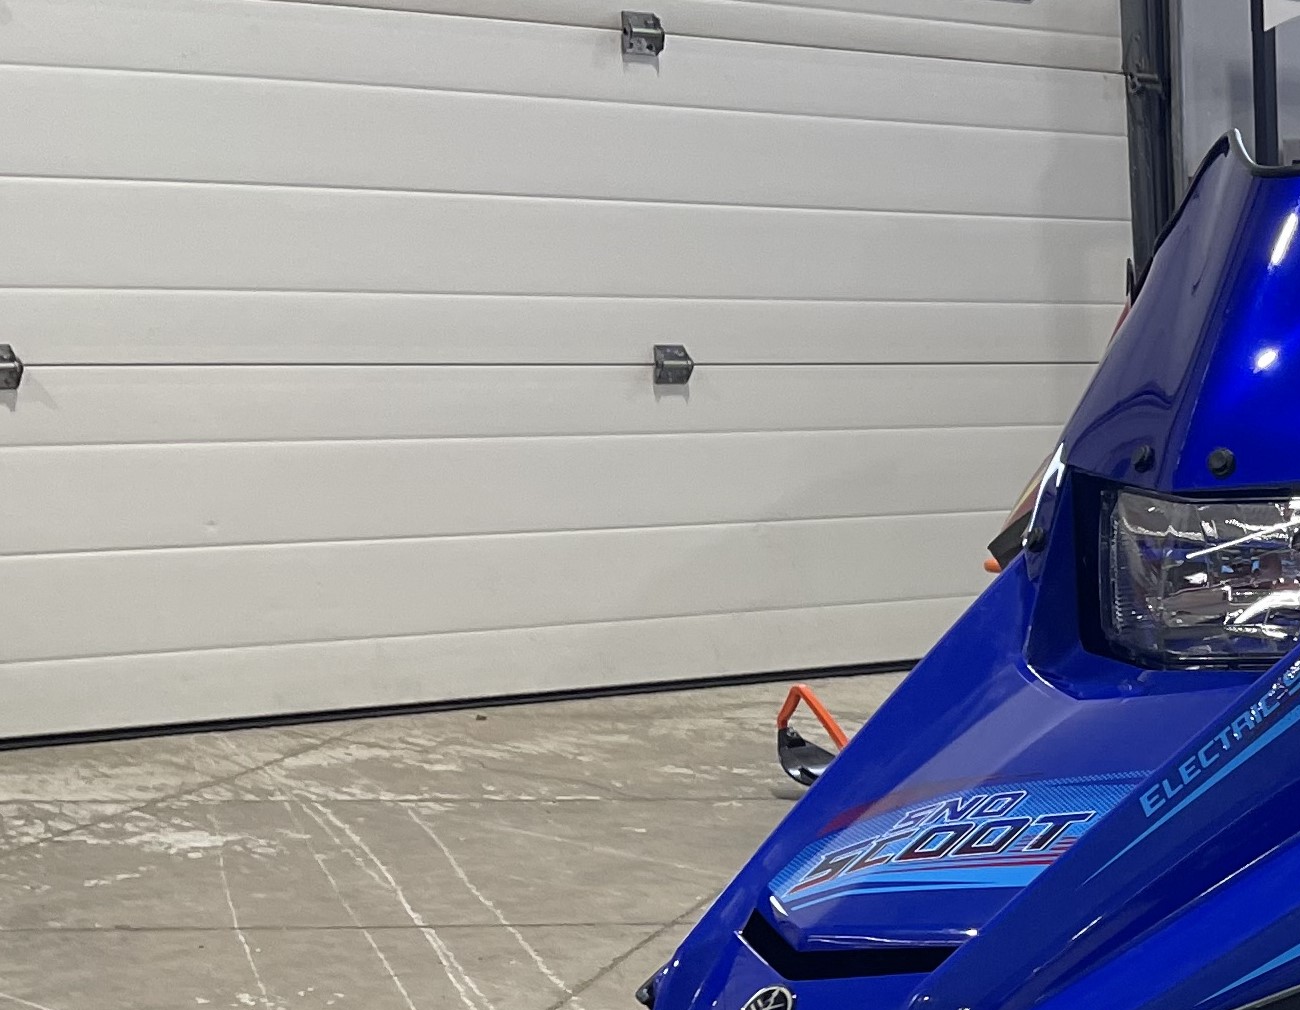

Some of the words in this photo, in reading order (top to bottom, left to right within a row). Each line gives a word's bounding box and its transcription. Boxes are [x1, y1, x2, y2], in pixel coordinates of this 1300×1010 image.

[1138, 688, 1281, 818] ELECTRIC
[780, 810, 1097, 900] SCOOT
[892, 790, 1028, 831] SNO
